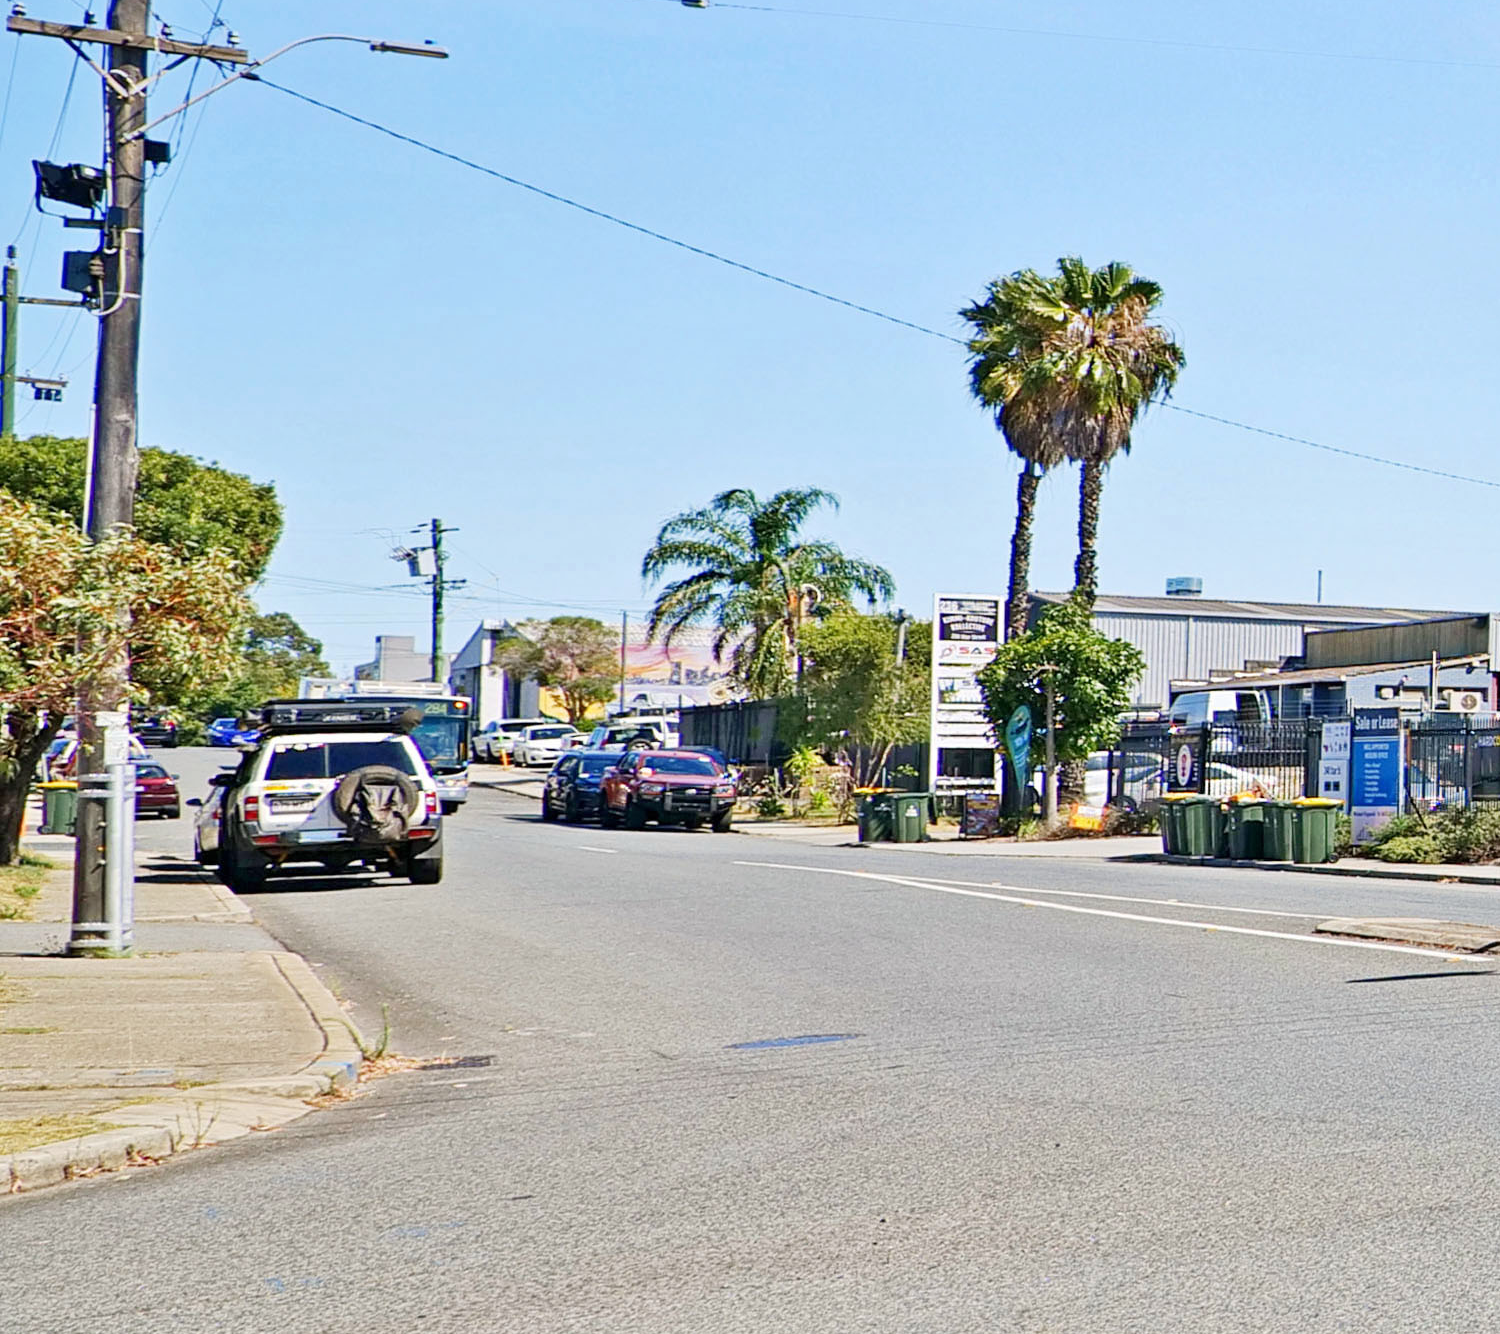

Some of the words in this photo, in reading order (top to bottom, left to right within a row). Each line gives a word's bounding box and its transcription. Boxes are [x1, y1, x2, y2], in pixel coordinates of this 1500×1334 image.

[1355, 716, 1370, 730] Sale
[1371, 719, 1379, 729] or
[1379, 715, 1398, 729] Lease
